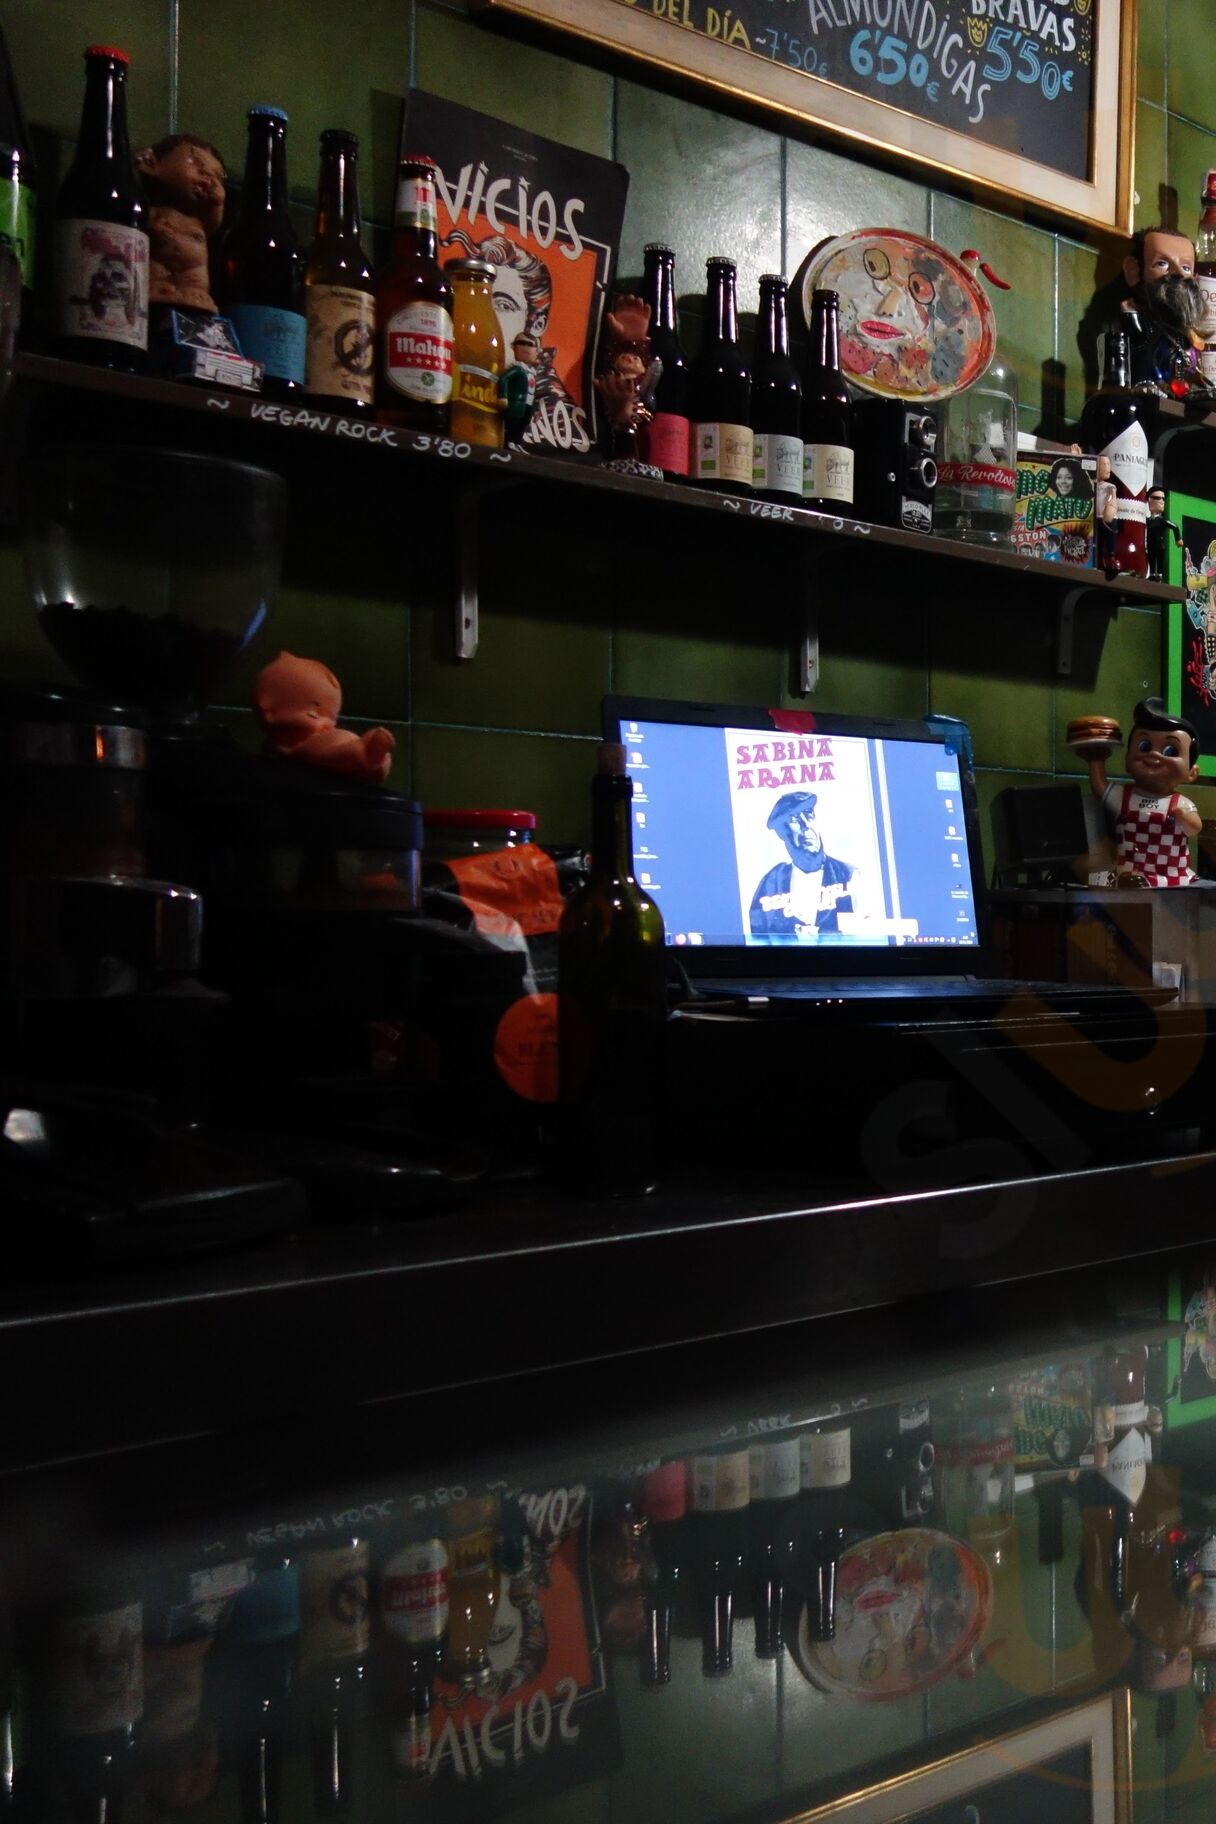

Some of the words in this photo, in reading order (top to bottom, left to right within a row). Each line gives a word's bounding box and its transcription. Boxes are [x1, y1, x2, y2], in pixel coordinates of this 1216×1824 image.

[250, 402, 330, 432] VEGAN
[335, 422, 399, 447] ROCK
[412, 435, 472, 459] 3'80
[736, 738, 834, 765] SABINA
[737, 762, 836, 790] ARANA
